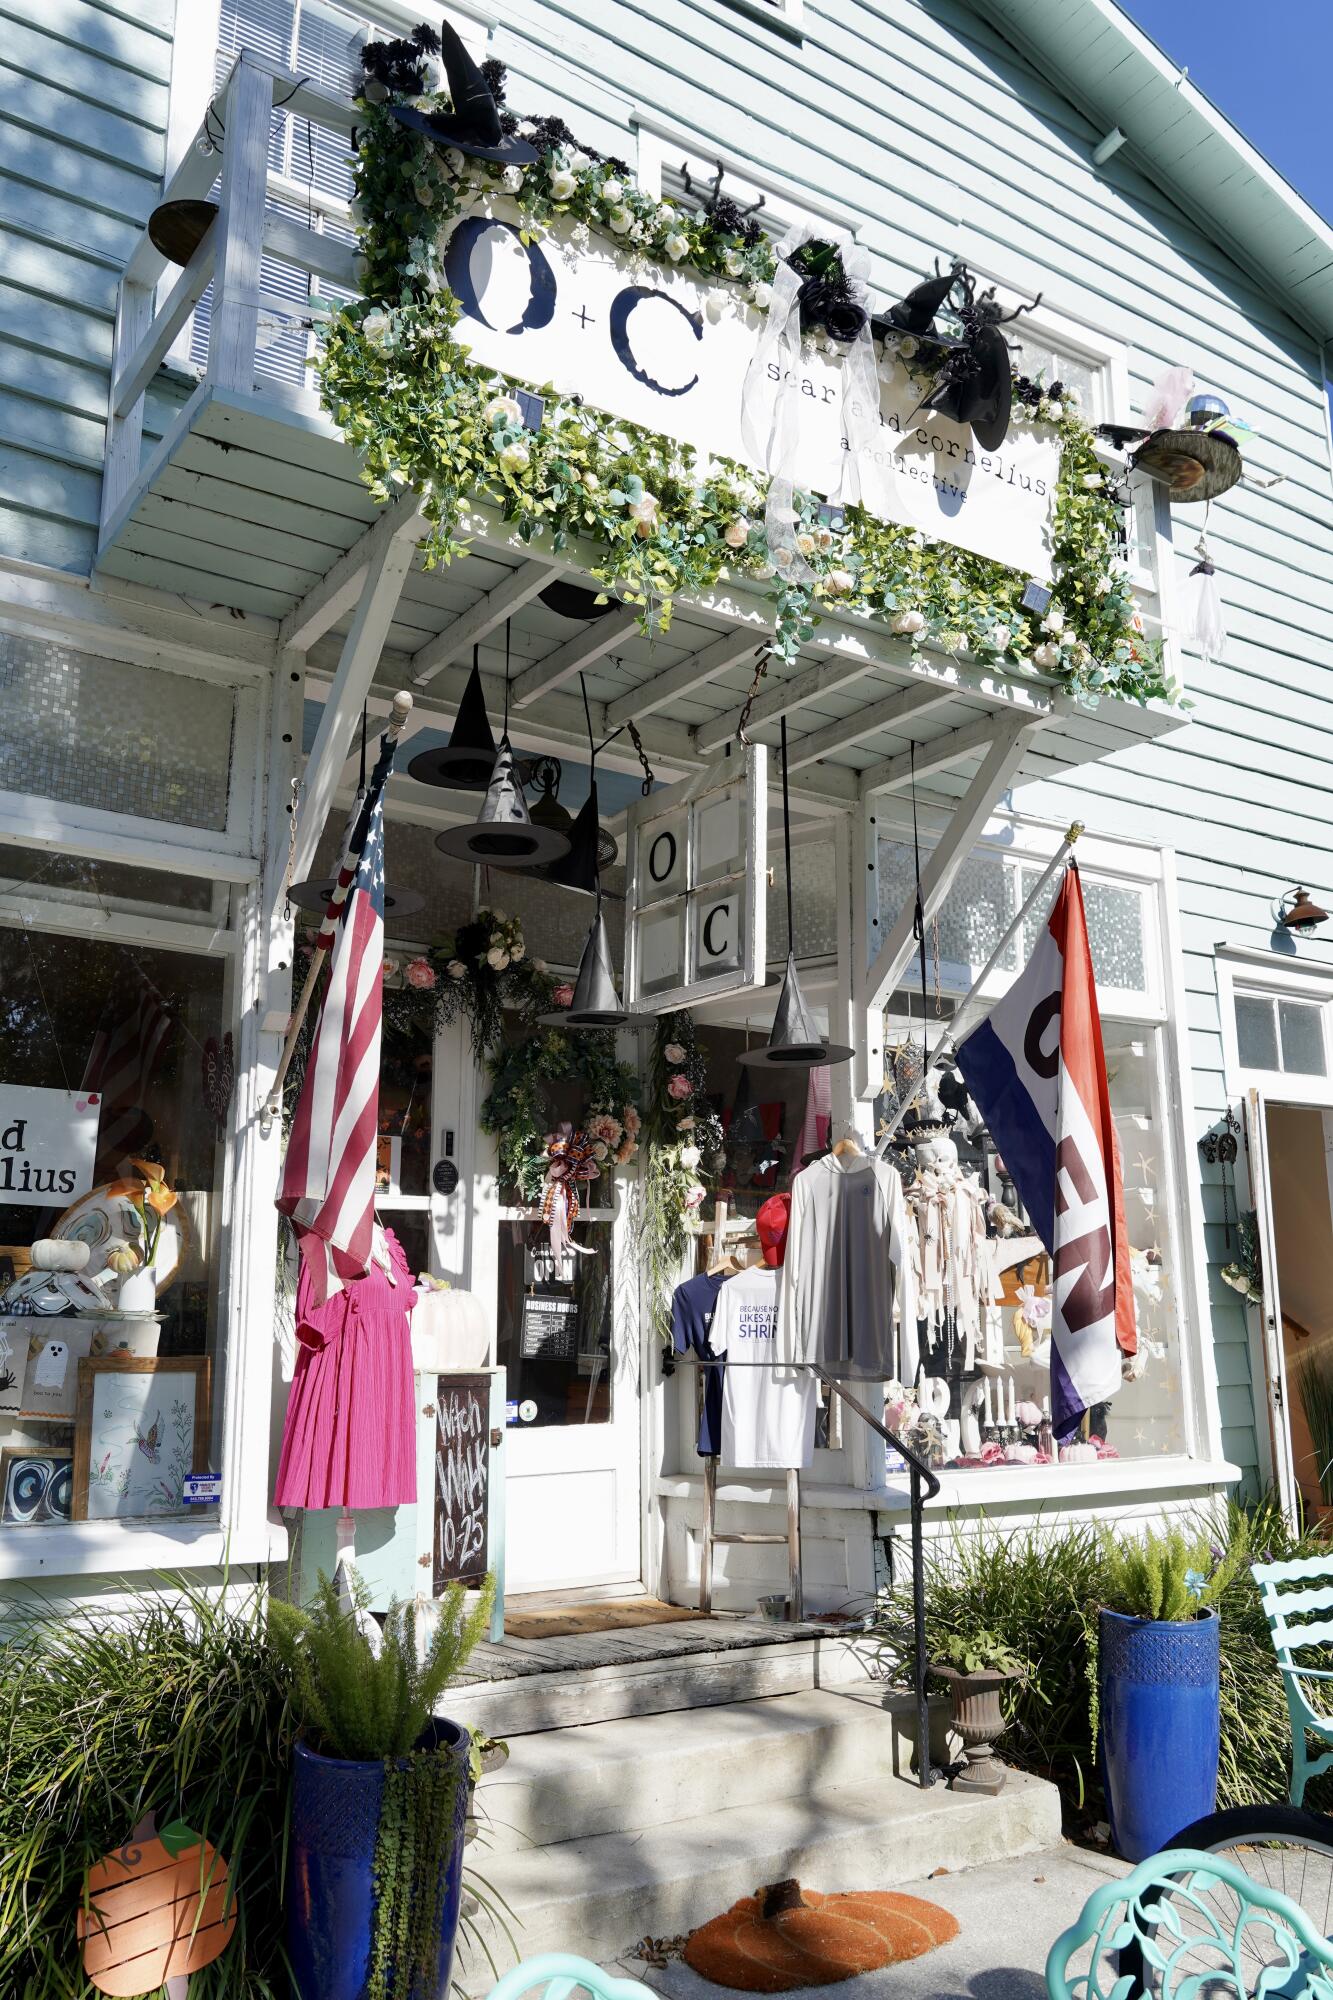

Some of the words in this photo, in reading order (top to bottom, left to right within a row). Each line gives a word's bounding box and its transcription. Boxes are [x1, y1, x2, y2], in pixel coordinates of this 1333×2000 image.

[609, 285, 703, 397] C
[749, 358, 836, 404] scar
[916, 427, 1046, 497] cornelius
[649, 831, 677, 882] O
[703, 904, 730, 956] C
[525, 1300, 557, 1312] BUSINESS
[557, 1302, 578, 1314] HOURS
[739, 1313, 764, 1323] LIKES
[765, 1313, 771, 1323] A
